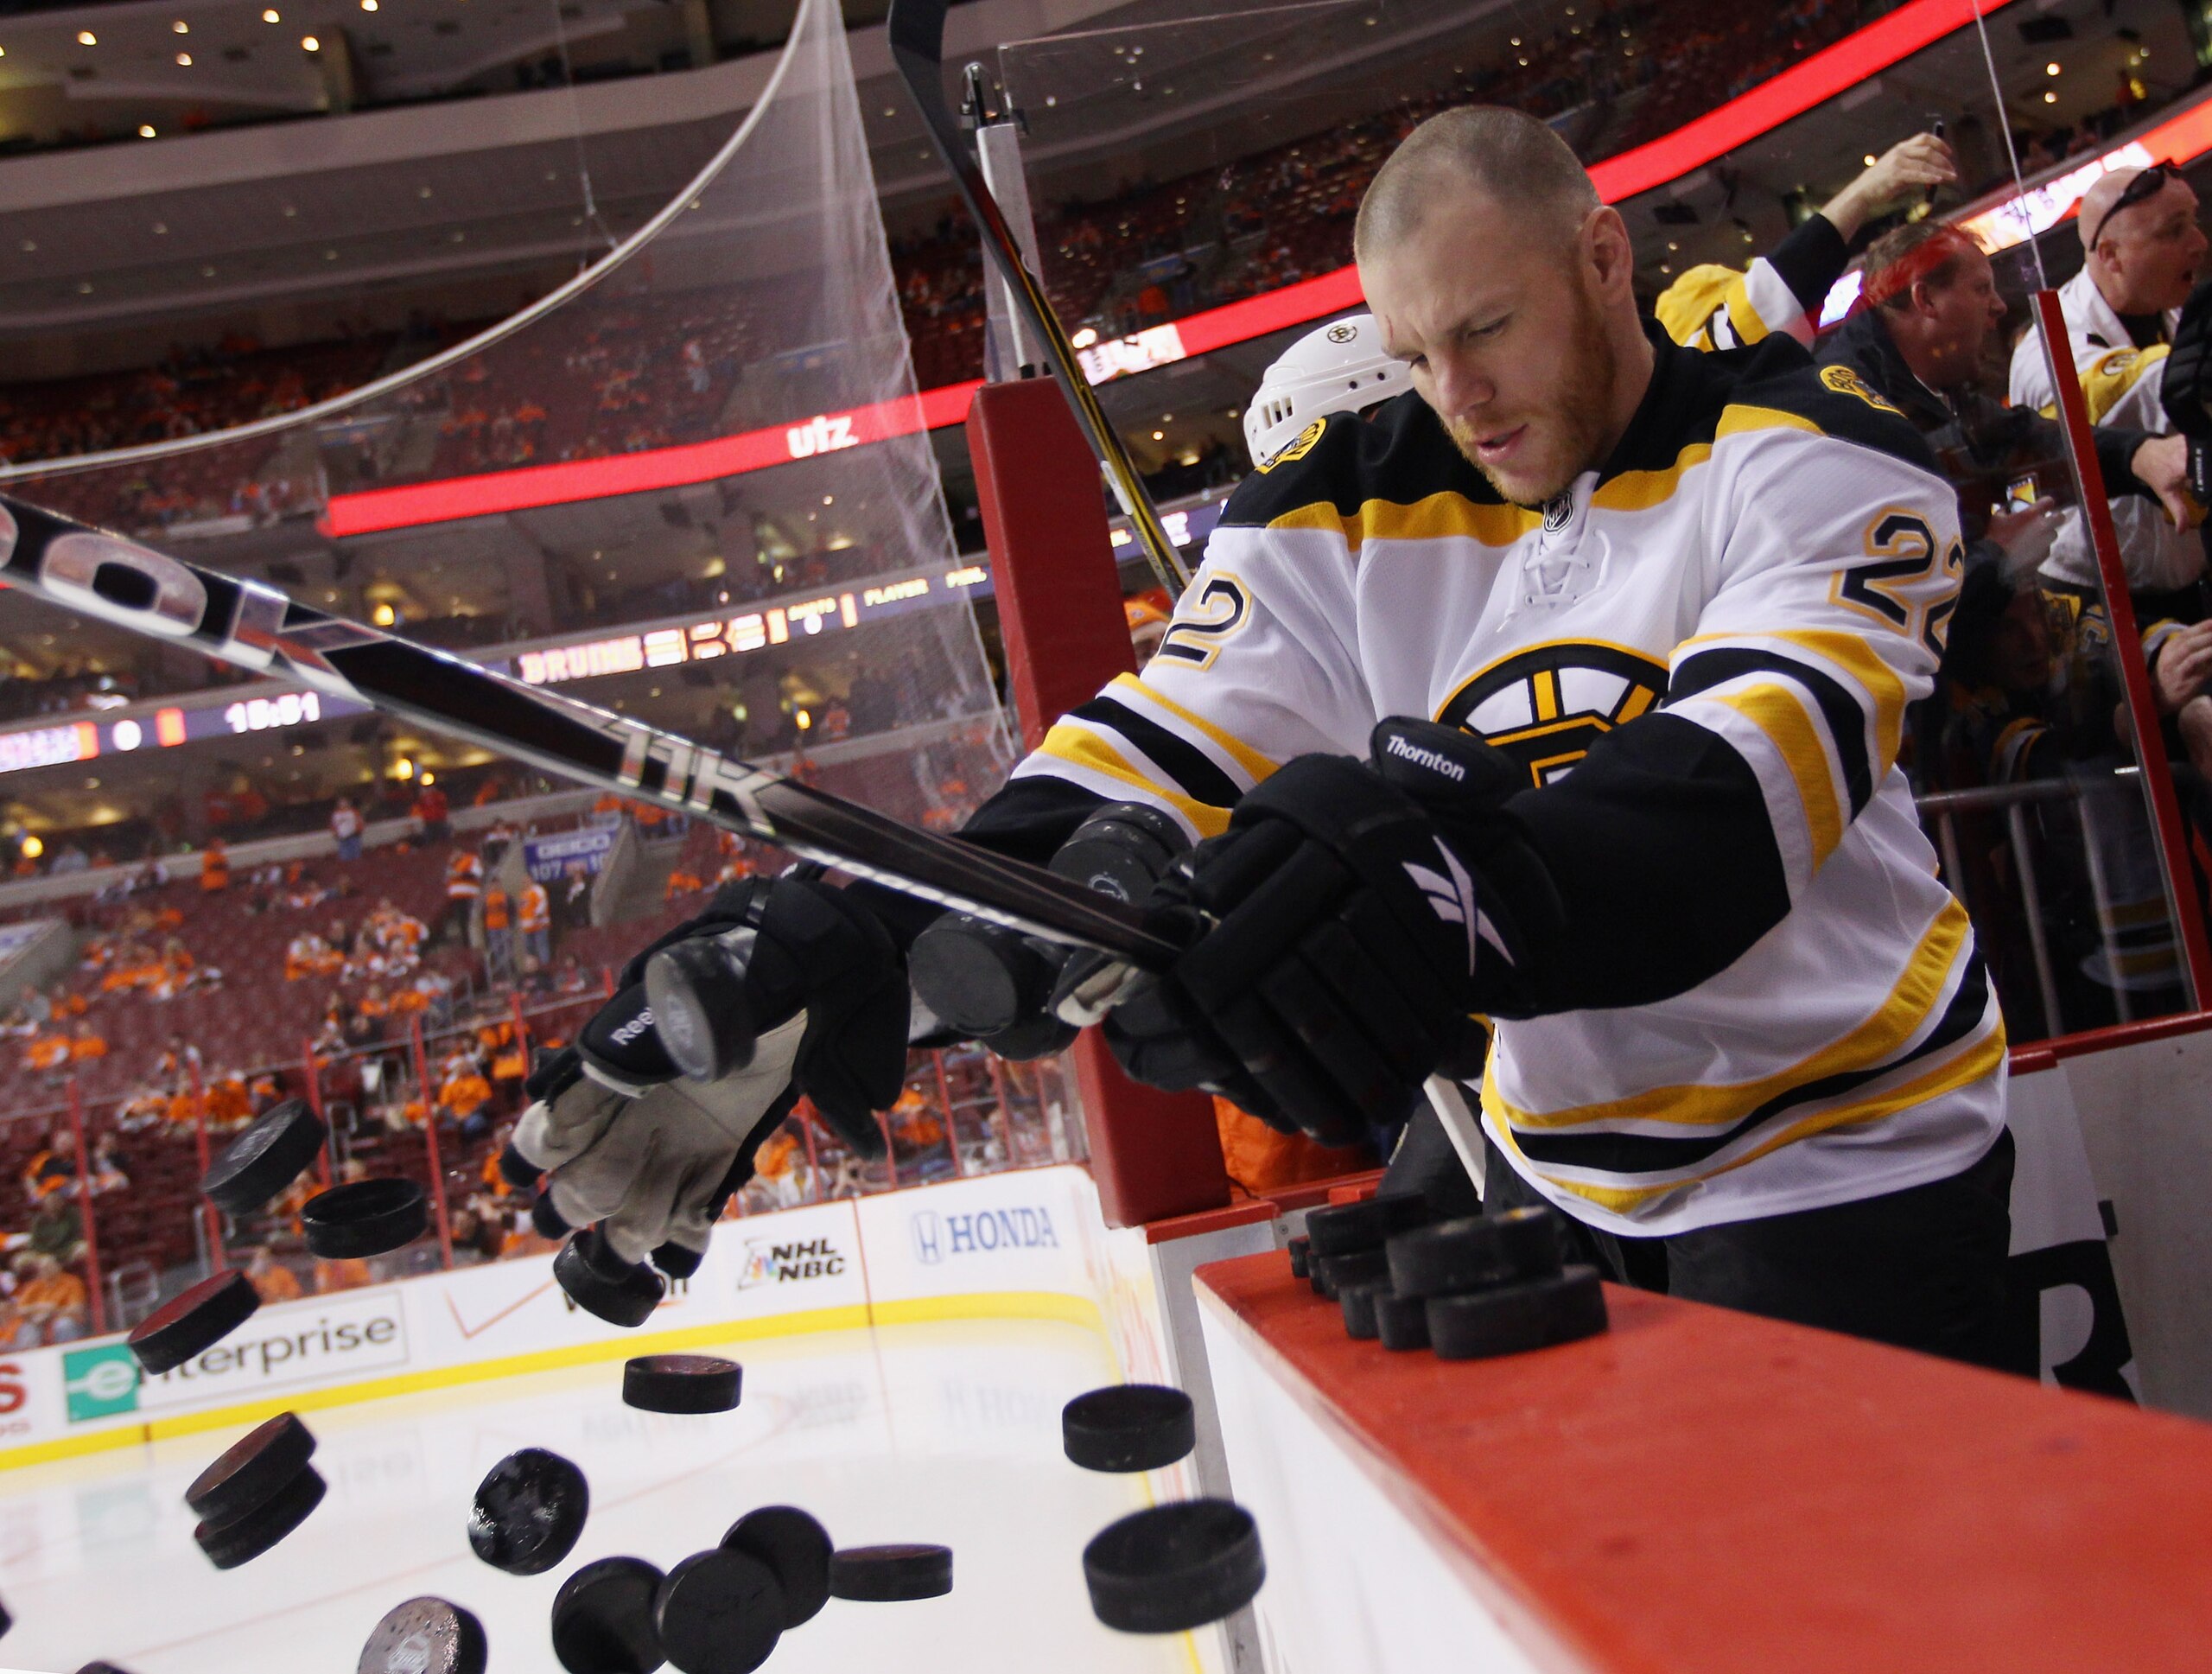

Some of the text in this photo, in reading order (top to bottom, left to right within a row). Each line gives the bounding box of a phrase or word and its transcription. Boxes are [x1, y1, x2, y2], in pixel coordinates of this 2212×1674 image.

[518, 635, 644, 684] BRUINS
[1387, 735, 1465, 782] Thornton
[609, 1007, 656, 1047] Ree
[772, 1237, 837, 1262] NHL
[947, 1206, 1059, 1253] HONDA
[779, 1257, 845, 1283] NBC
[83, 1315, 396, 1401] eerprise
